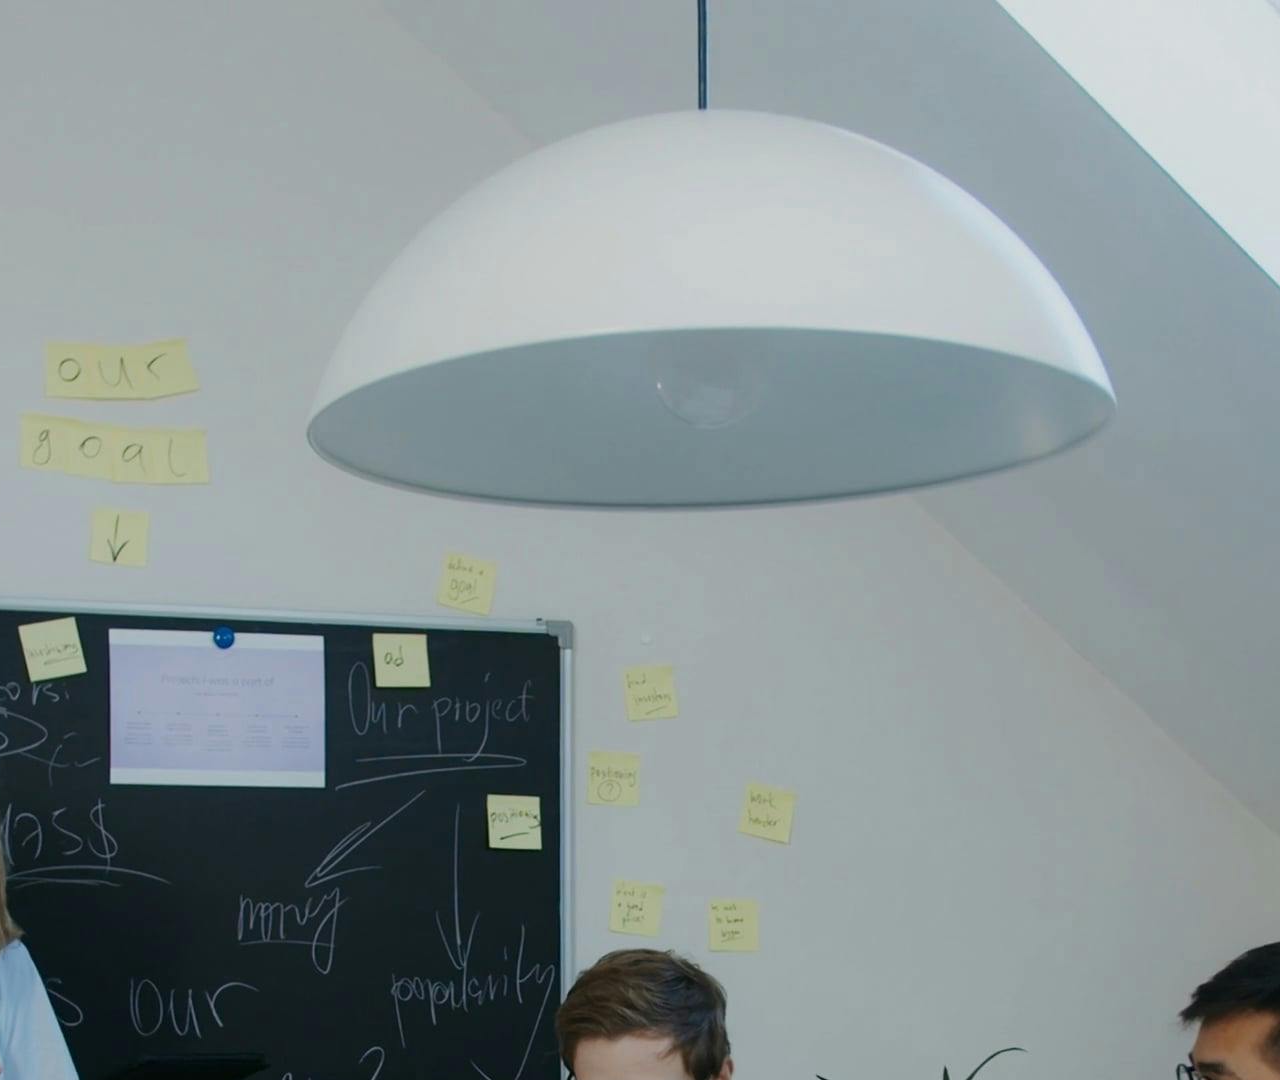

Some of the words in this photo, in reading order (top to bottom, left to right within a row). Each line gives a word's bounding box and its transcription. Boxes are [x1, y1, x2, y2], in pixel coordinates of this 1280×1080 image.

[57, 352, 168, 391] our
[31, 428, 188, 478] goal
[347, 660, 419, 737] Our
[431, 671, 536, 763] project
